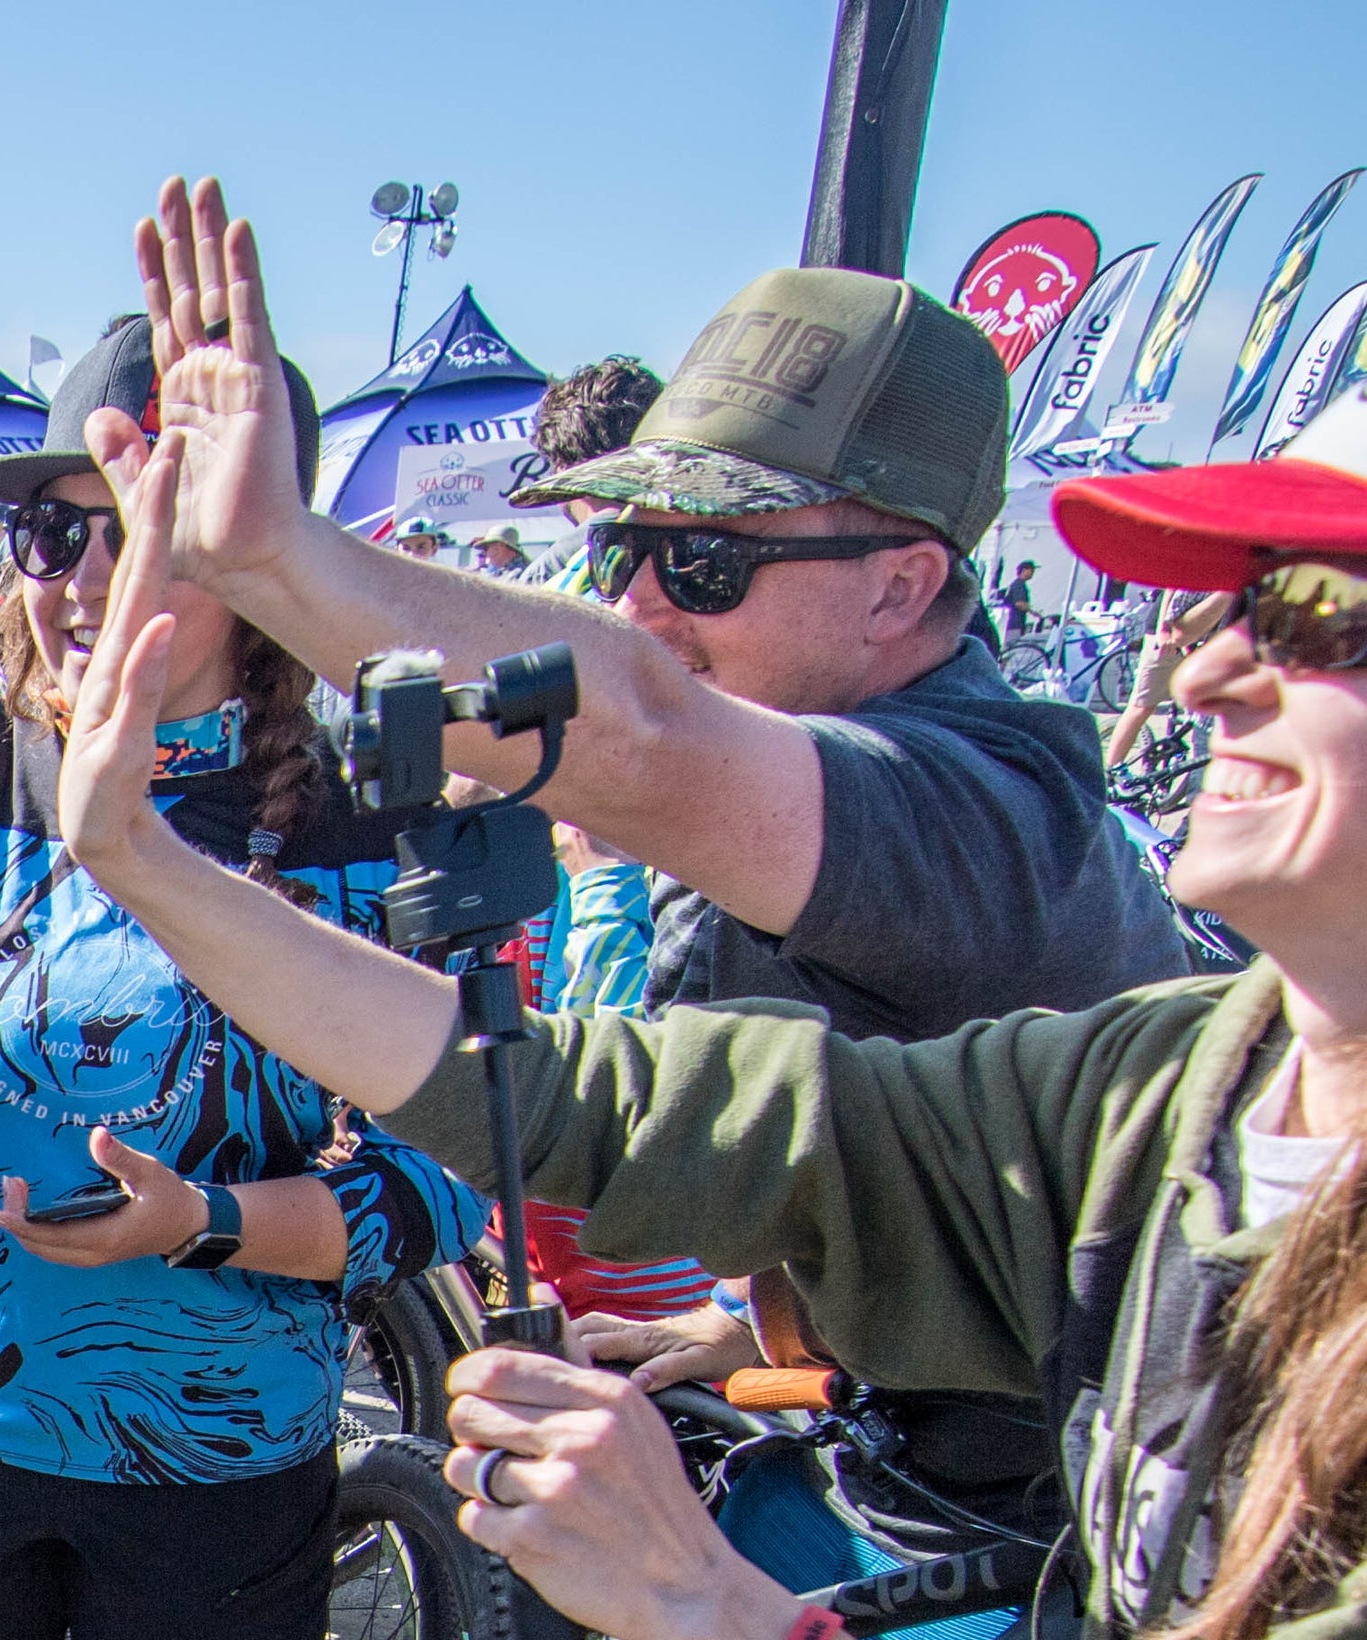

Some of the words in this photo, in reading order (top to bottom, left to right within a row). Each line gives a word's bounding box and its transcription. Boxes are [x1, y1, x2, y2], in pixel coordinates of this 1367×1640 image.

[1050, 313, 1112, 410] fabric
[1288, 339, 1334, 427] fabric
[1130, 404, 1154, 414] ATM
[469, 416, 533, 443] OTT
[415, 475, 438, 496] SEA
[440, 472, 485, 492] OTTER
[425, 492, 470, 507] CLASSIC
[40, 1039, 131, 1065] MCXCVIII
[61, 1112, 87, 1128] IN
[100, 1039, 224, 1127] VANCOUVER
